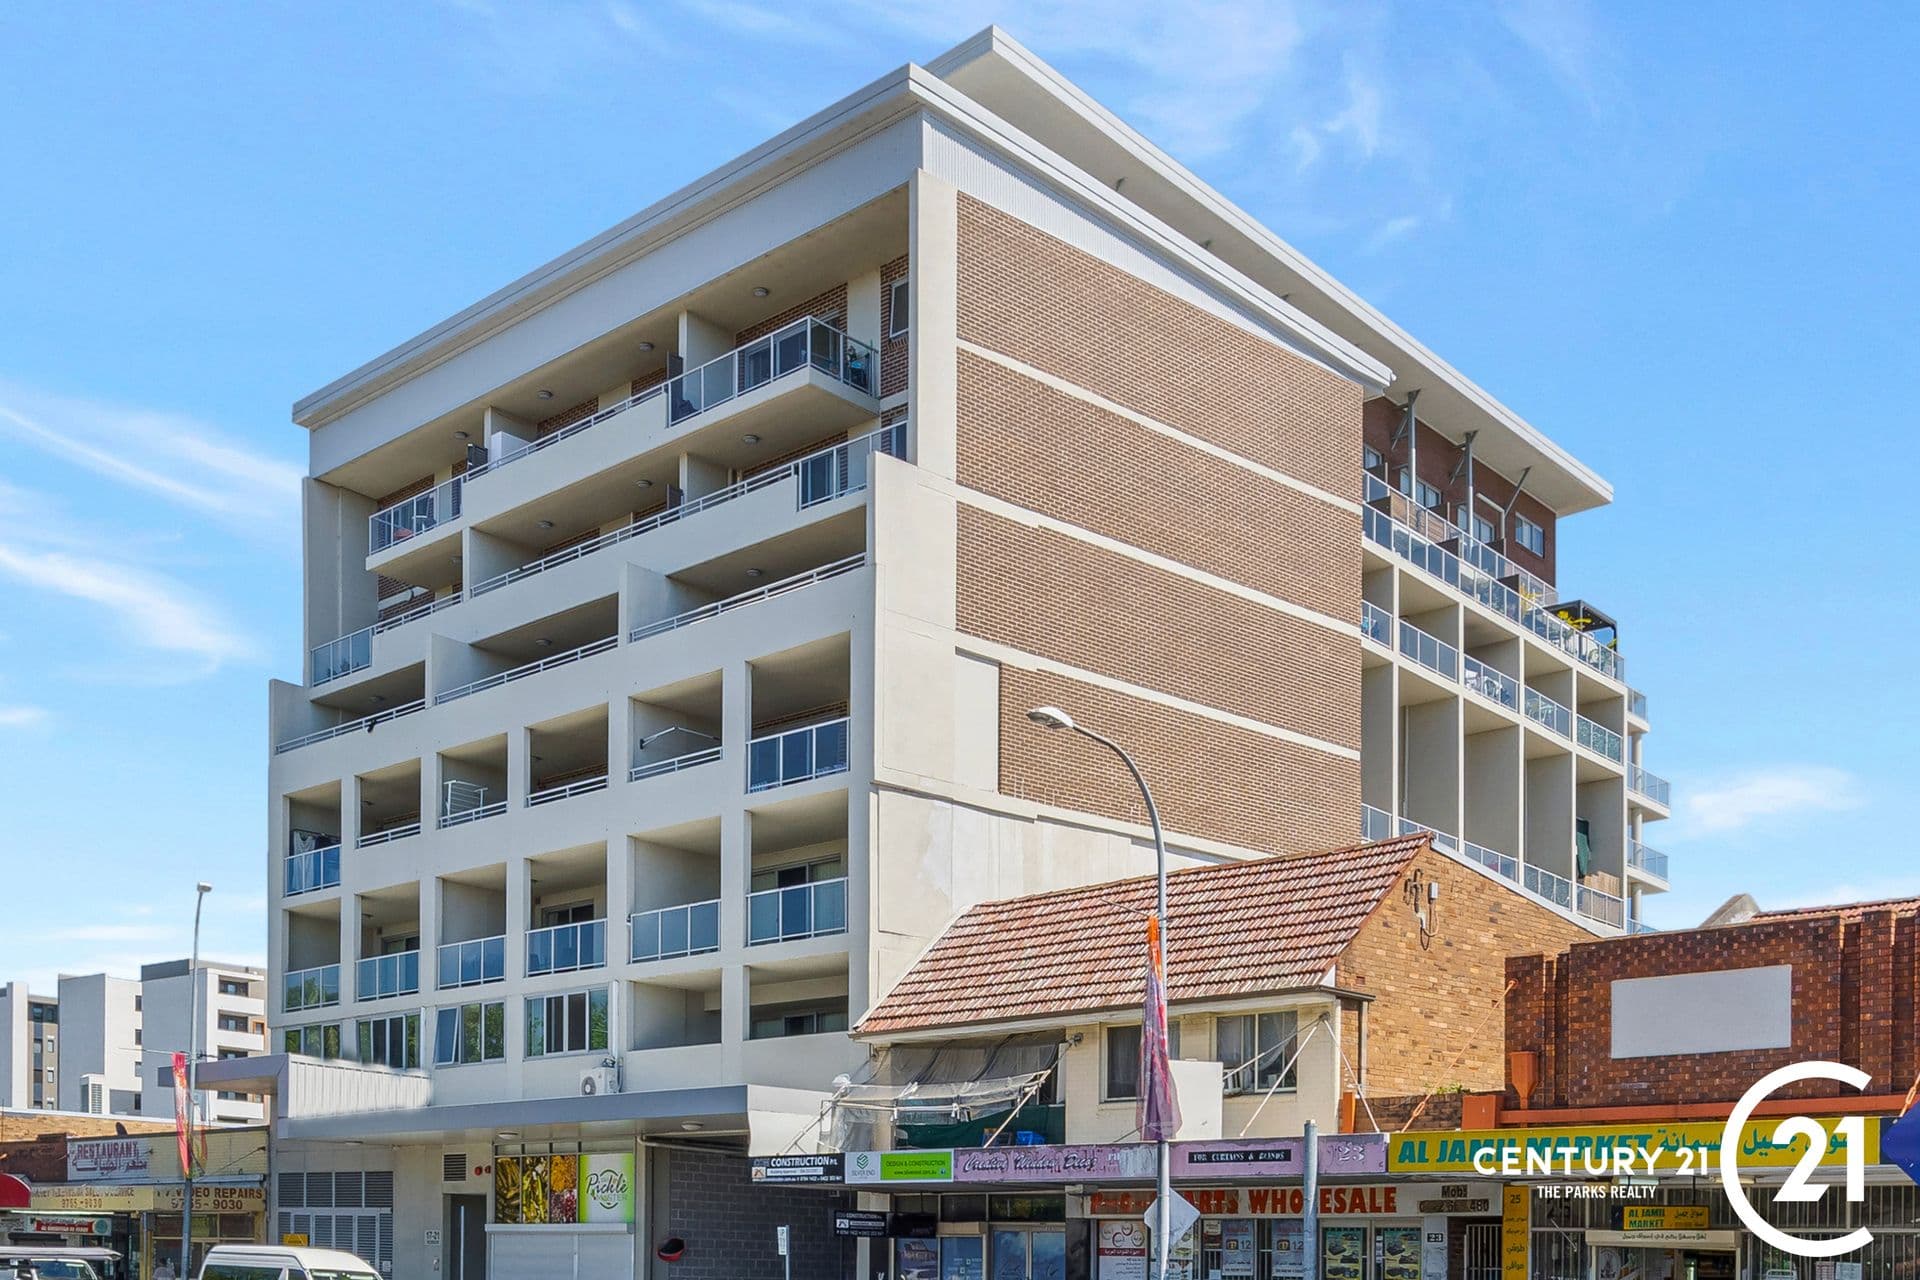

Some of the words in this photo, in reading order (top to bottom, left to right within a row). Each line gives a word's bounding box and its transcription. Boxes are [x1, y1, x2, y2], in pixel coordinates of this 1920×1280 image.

[77, 1141, 138, 1159] RESTAURANT
[1337, 1144, 1366, 1162] 23
[1397, 1139, 1430, 1164] AL
[1436, 1137, 1517, 1163] JAMIL
[1524, 1134, 1653, 1162] MARKET
[770, 1157, 830, 1167] CONSTRUCTION
[963, 1153, 1009, 1173] Creative
[1014, 1153, 1057, 1171] Window
[1063, 1153, 1098, 1171] Decor
[585, 1173, 628, 1194] Pickle
[214, 1187, 263, 1199] REPAIRS
[1510, 1194, 1521, 1204] 25
[1247, 1186, 1398, 1215] WHOESALE
[1628, 1208, 1639, 1218] AL
[1642, 1208, 1666, 1218] JAMIL
[1629, 1219, 1664, 1229] MARKET
[1428, 1234, 1442, 1242] 23
[1241, 1240, 1251, 1249] 12
